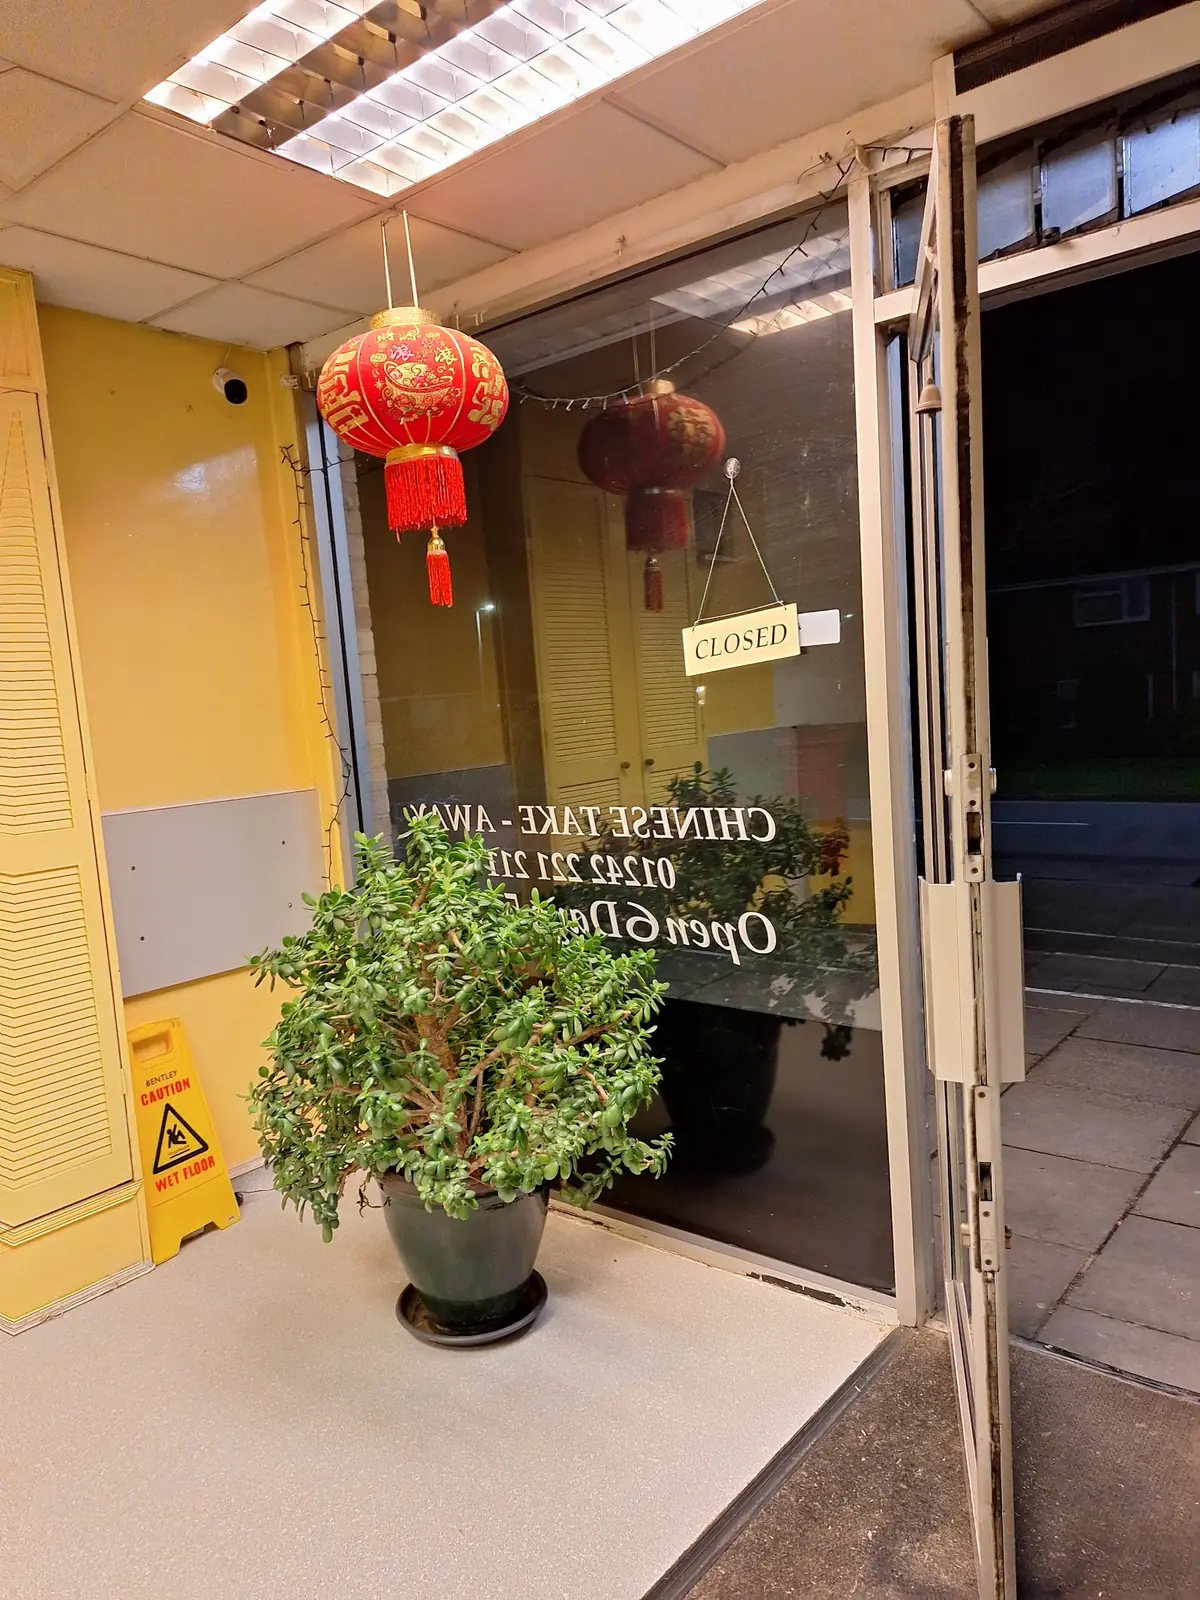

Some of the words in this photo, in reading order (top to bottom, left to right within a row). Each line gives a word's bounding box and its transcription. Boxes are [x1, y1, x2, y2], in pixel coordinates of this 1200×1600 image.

[695, 623, 787, 660] CLOSED
[140, 1077, 191, 1106] CAUTION
[145, 1070, 178, 1087] BENTLEY
[154, 1171, 180, 1192] WET
[183, 1155, 216, 1180] FLOOR
